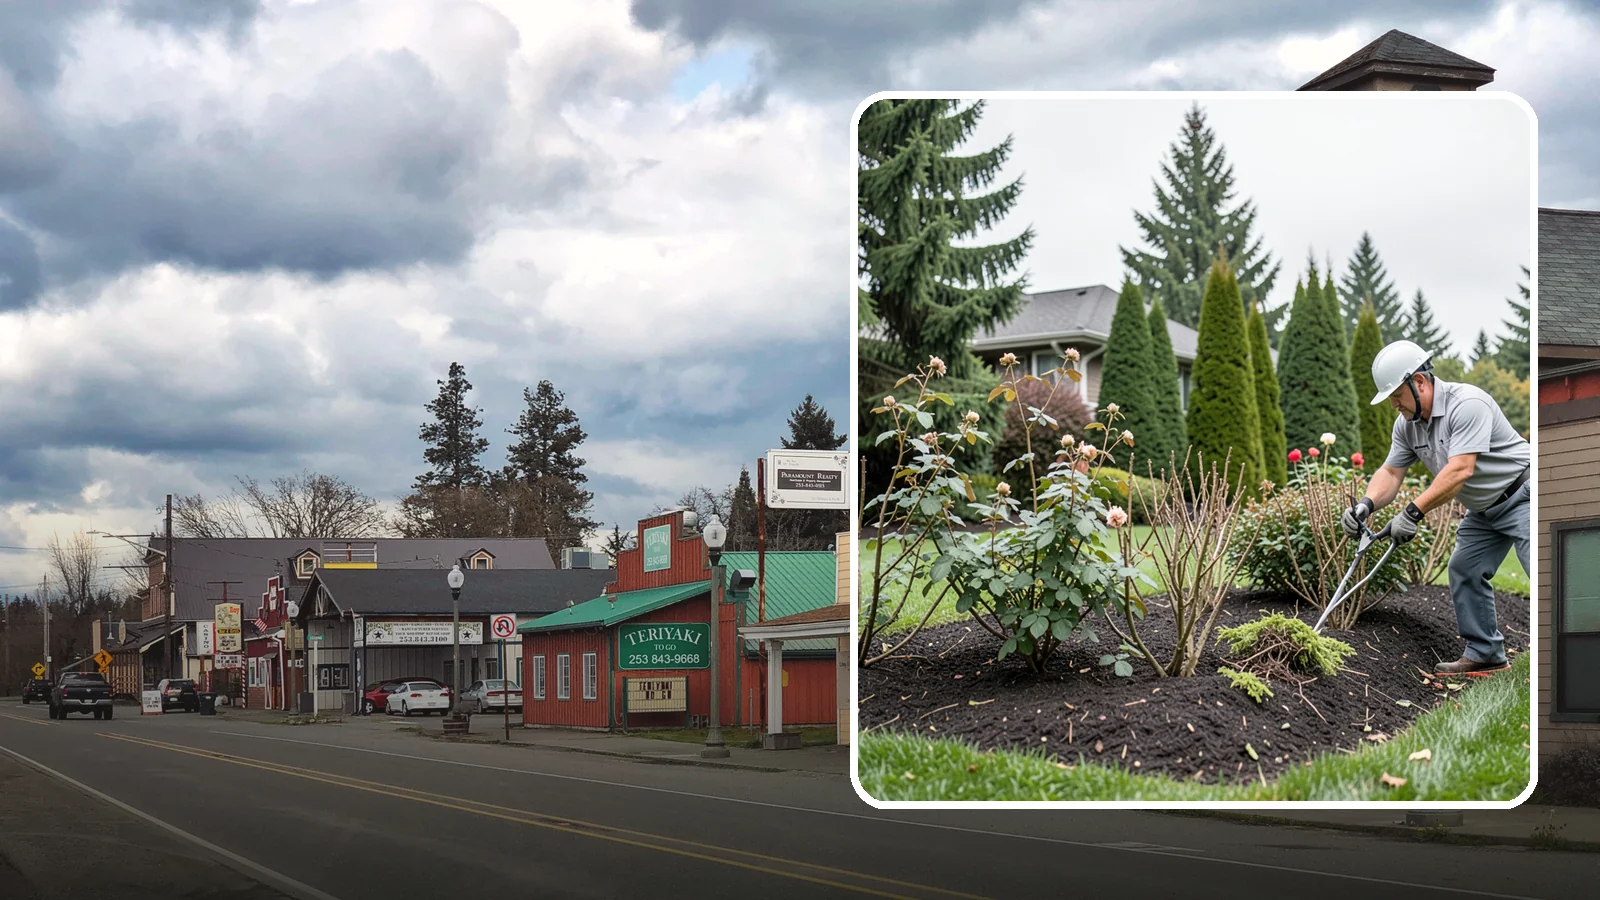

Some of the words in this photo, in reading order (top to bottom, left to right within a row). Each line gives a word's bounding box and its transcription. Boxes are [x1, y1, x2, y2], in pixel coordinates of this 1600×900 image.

[817, 472, 839, 480] REALTY
[624, 627, 702, 646] TERIYAKI
[628, 654, 649, 664] 253
[651, 653, 700, 664] 843-9668
